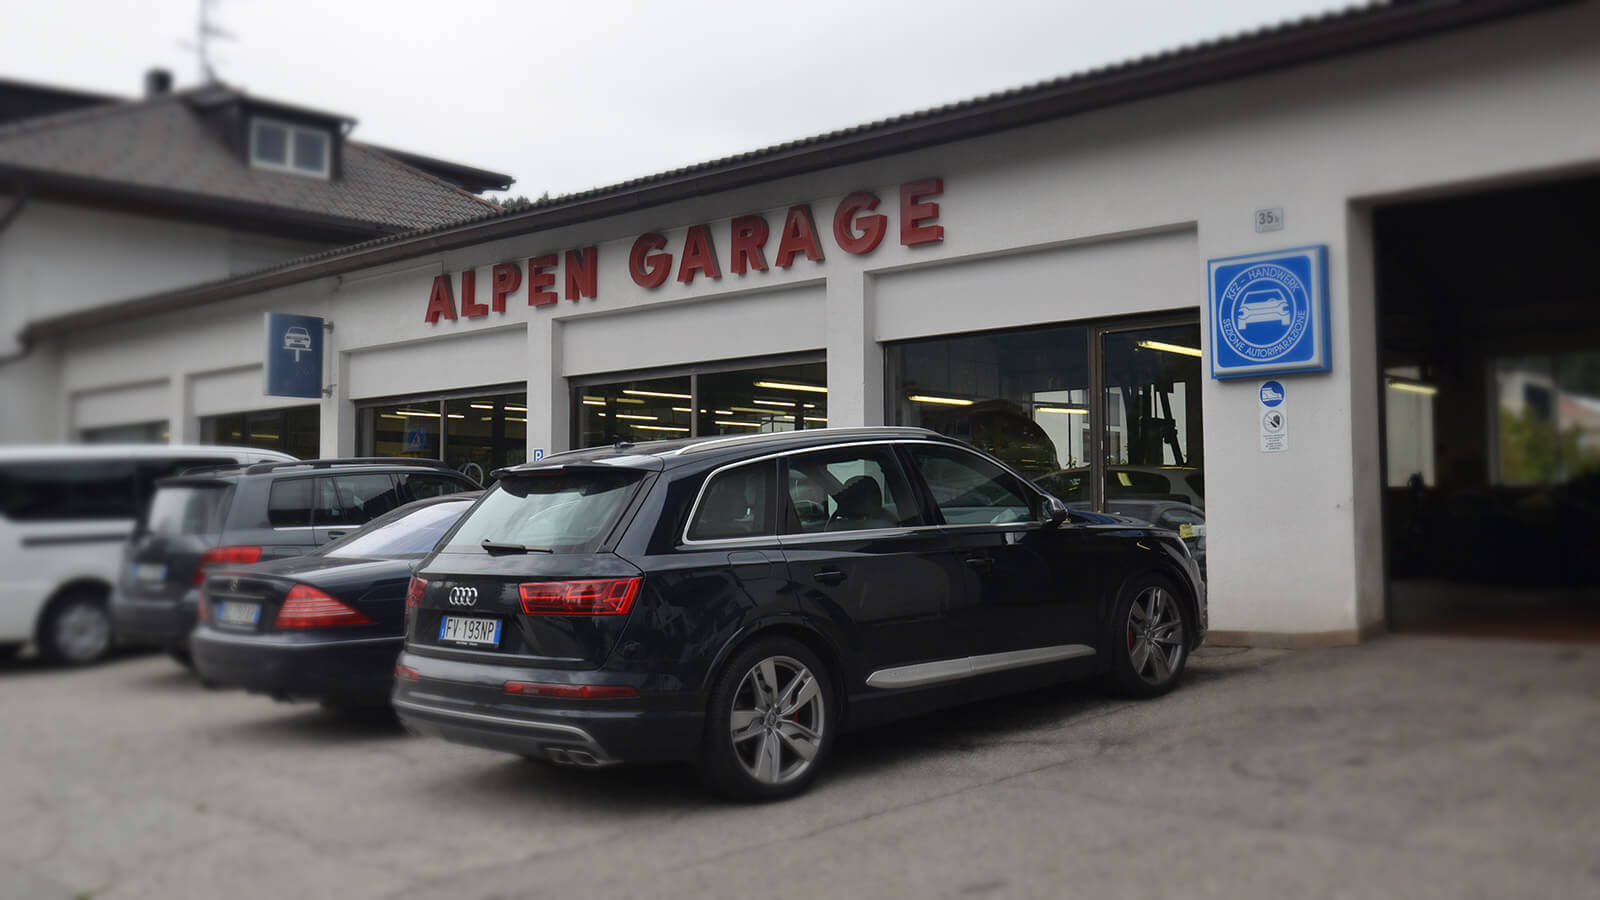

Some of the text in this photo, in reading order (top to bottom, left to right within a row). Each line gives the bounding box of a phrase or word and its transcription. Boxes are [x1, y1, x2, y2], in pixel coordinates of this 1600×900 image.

[424, 178, 945, 323] ALPEN GARAGE
[1226, 281, 1241, 300] KFZ
[1247, 267, 1300, 293] HANDWERK
[1223, 310, 1306, 358] SEZIONE AUTORIPARAZIONE
[446, 618, 460, 638] FV
[463, 620, 495, 641] 193NP
